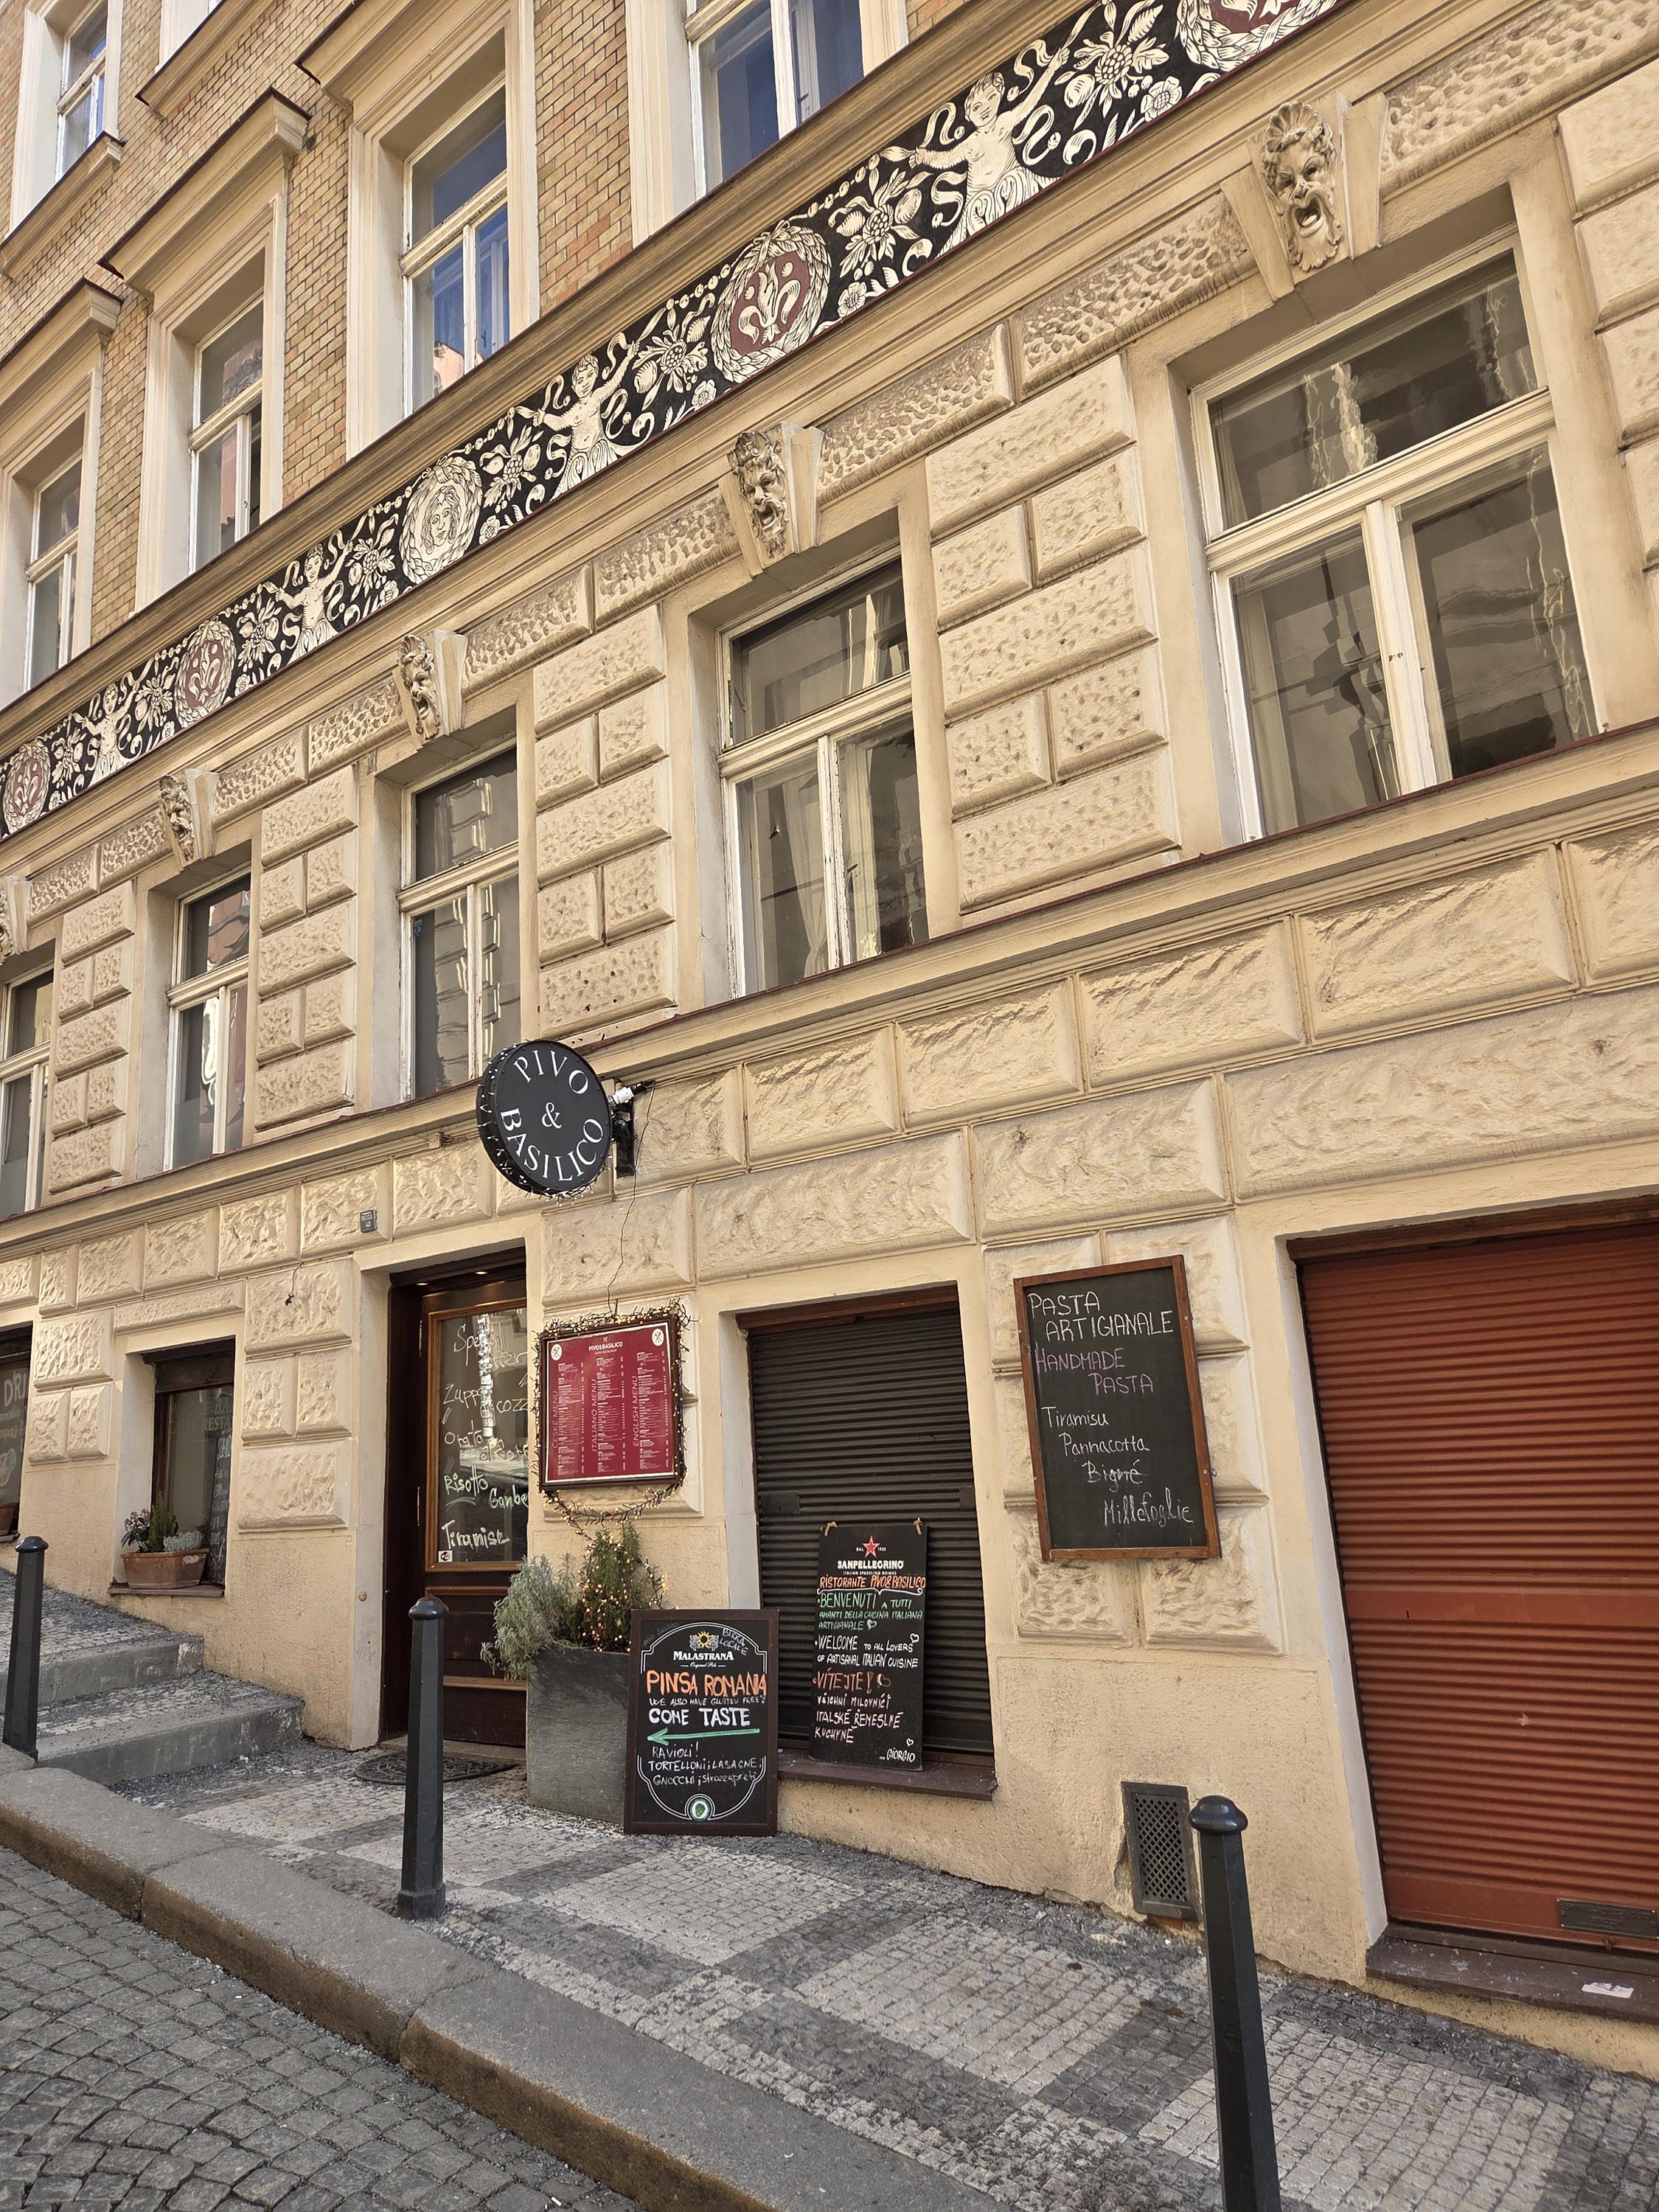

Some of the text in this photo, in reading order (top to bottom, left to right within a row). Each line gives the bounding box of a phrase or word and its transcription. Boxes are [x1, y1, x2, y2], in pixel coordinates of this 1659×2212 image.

[513, 1050, 588, 1094] PIVO
[541, 1102, 563, 1129] &
[501, 1107, 603, 1181] BASILICO
[1028, 1291, 1100, 1318] PASTA
[1046, 1310, 1174, 1342] ARTIGIANALE
[1034, 1344, 1126, 1374] HANDMADE
[1088, 1372, 1155, 1396] PASTA
[1040, 1405, 1109, 1427] Tiramisu
[1058, 1431, 1150, 1456] Pannacotta
[444, 1464, 488, 1496] Risotto
[837, 1560, 904, 1569] SANPELLEGRINO
[820, 1574, 866, 1588] RISTORANTE
[819, 1593, 877, 1609] BENVENUTI
[891, 1599, 912, 1610] TUTTI
[818, 1621, 864, 1630] ARTIGIANALE
[819, 1611, 842, 1619] AMANTI
[863, 1610, 888, 1619] CUCINA
[892, 1610, 923, 1620] ITALIANA
[818, 1635, 858, 1651] WELCOME
[886, 1640, 914, 1652] LOVERS
[673, 1651, 734, 1660] MALASTRANA
[827, 1653, 860, 1666] ARTISANAL
[863, 1653, 887, 1667] ITALIAN
[888, 1657, 919, 1669] CUISINE
[646, 1669, 767, 1697] PINSA ROMANA
[650, 1697, 667, 1706] WE
[670, 1697, 687, 1706] ALSO
[690, 1697, 707, 1706] HAVE
[649, 1706, 751, 1728] COME TASTE
[816, 1709, 852, 1725] ITALSKÉ
